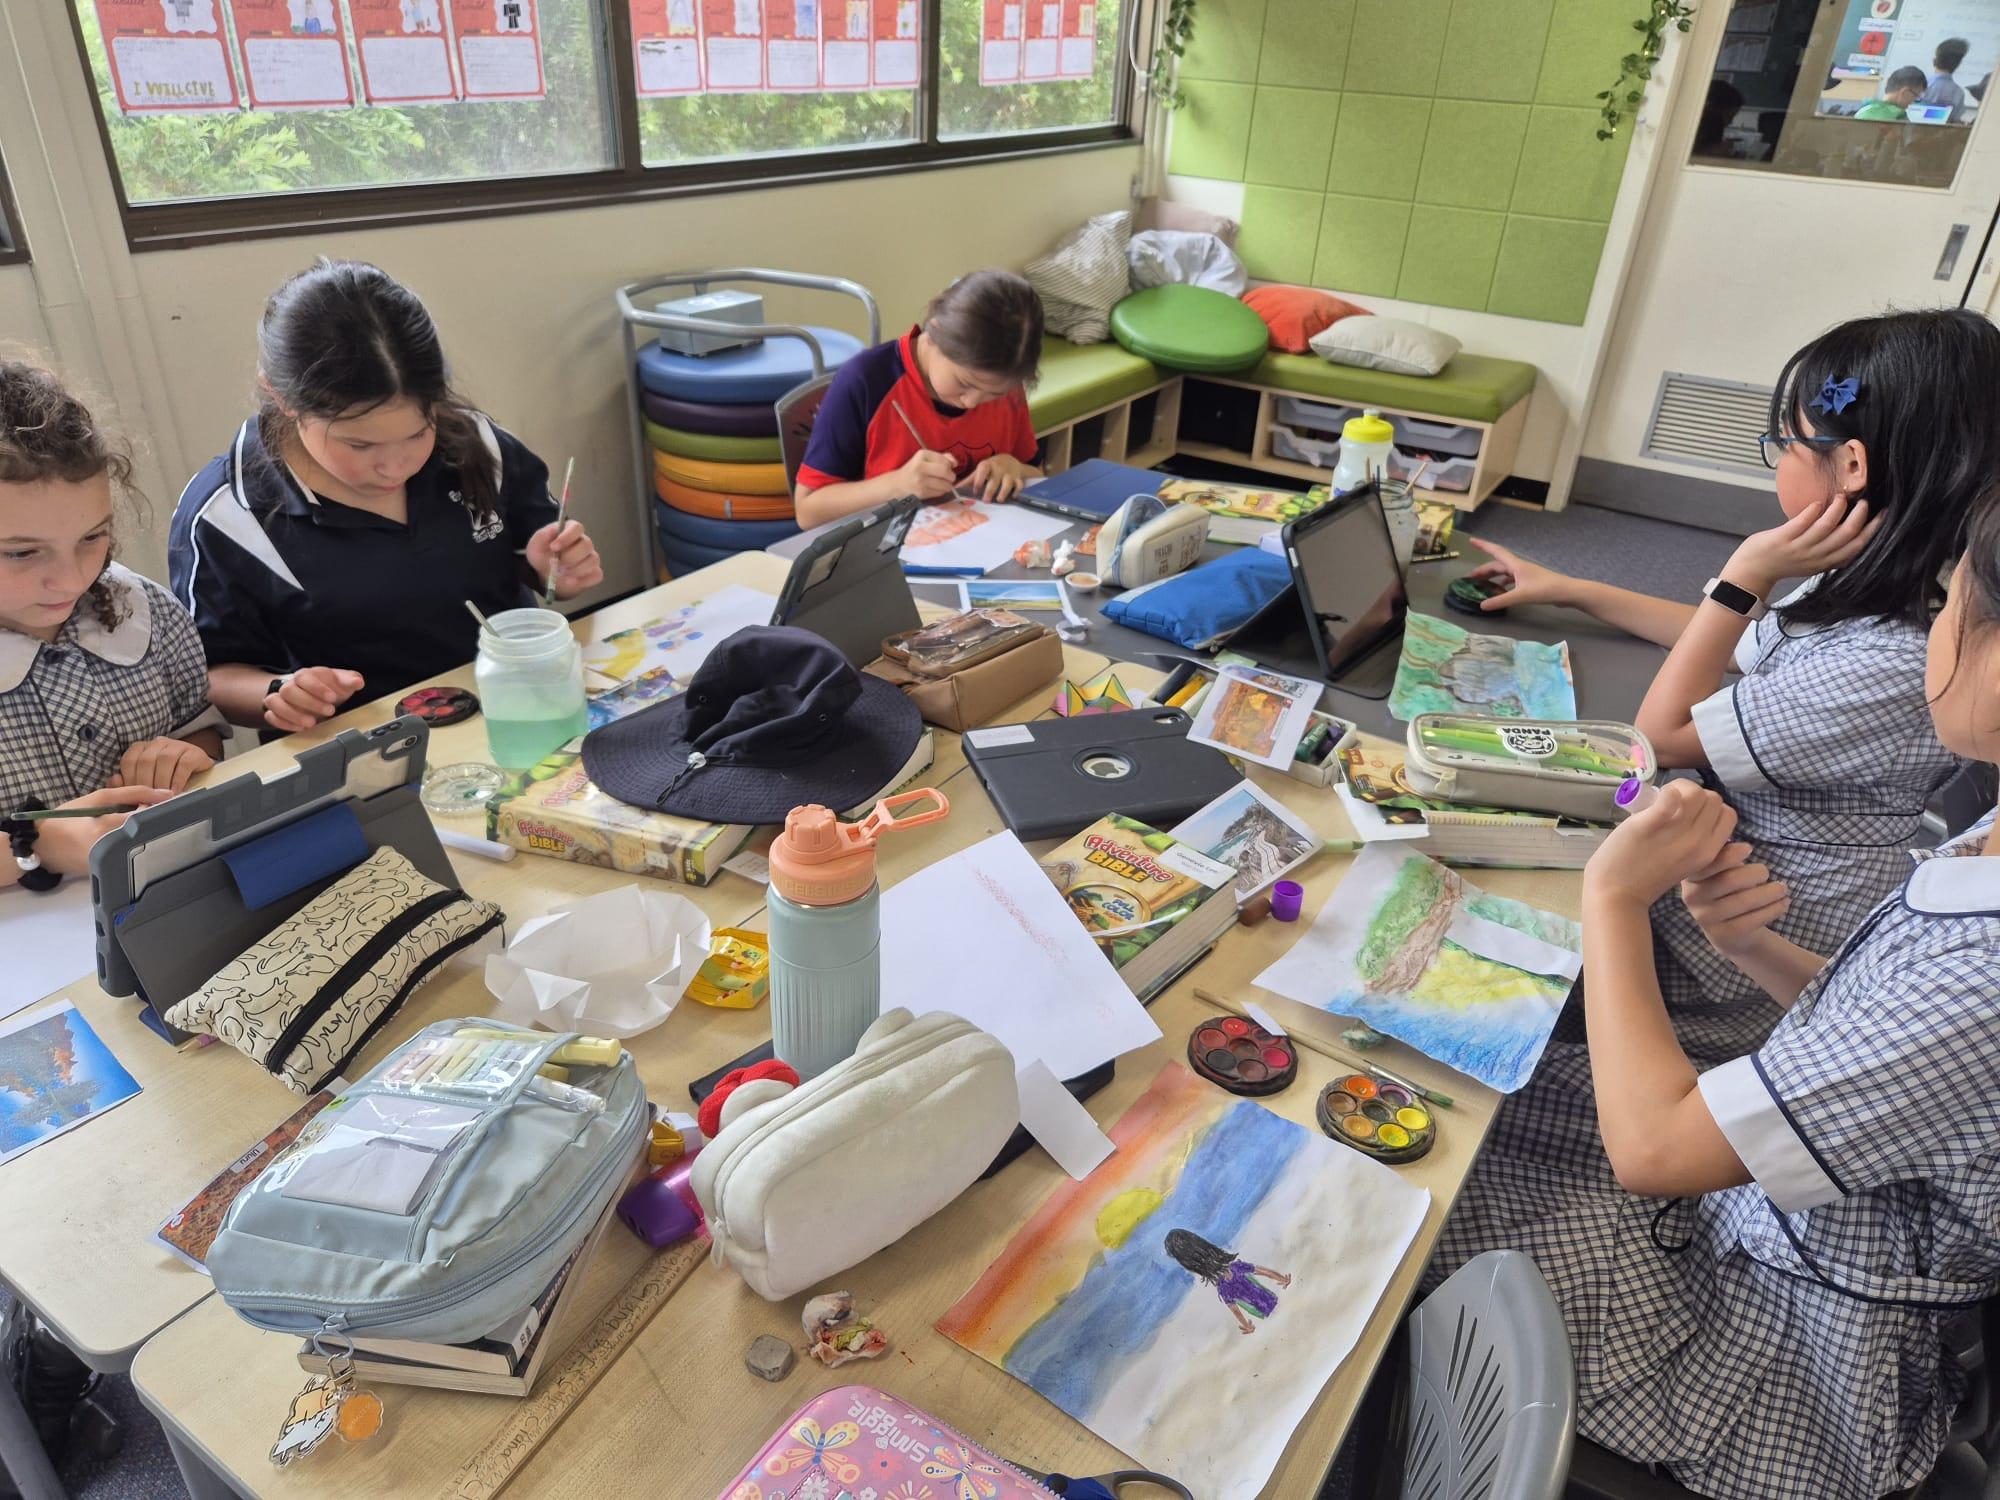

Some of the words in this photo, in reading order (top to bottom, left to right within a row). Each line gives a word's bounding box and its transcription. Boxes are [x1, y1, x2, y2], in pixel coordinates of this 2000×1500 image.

[1502, 727, 1551, 739] PANDA
[528, 834, 567, 853] BIBLE
[1084, 834, 1174, 882] Adventure
[1085, 850, 1150, 883] BIBLE
[240, 1148, 260, 1165] Uluru
[847, 1400, 930, 1462] smiggle
